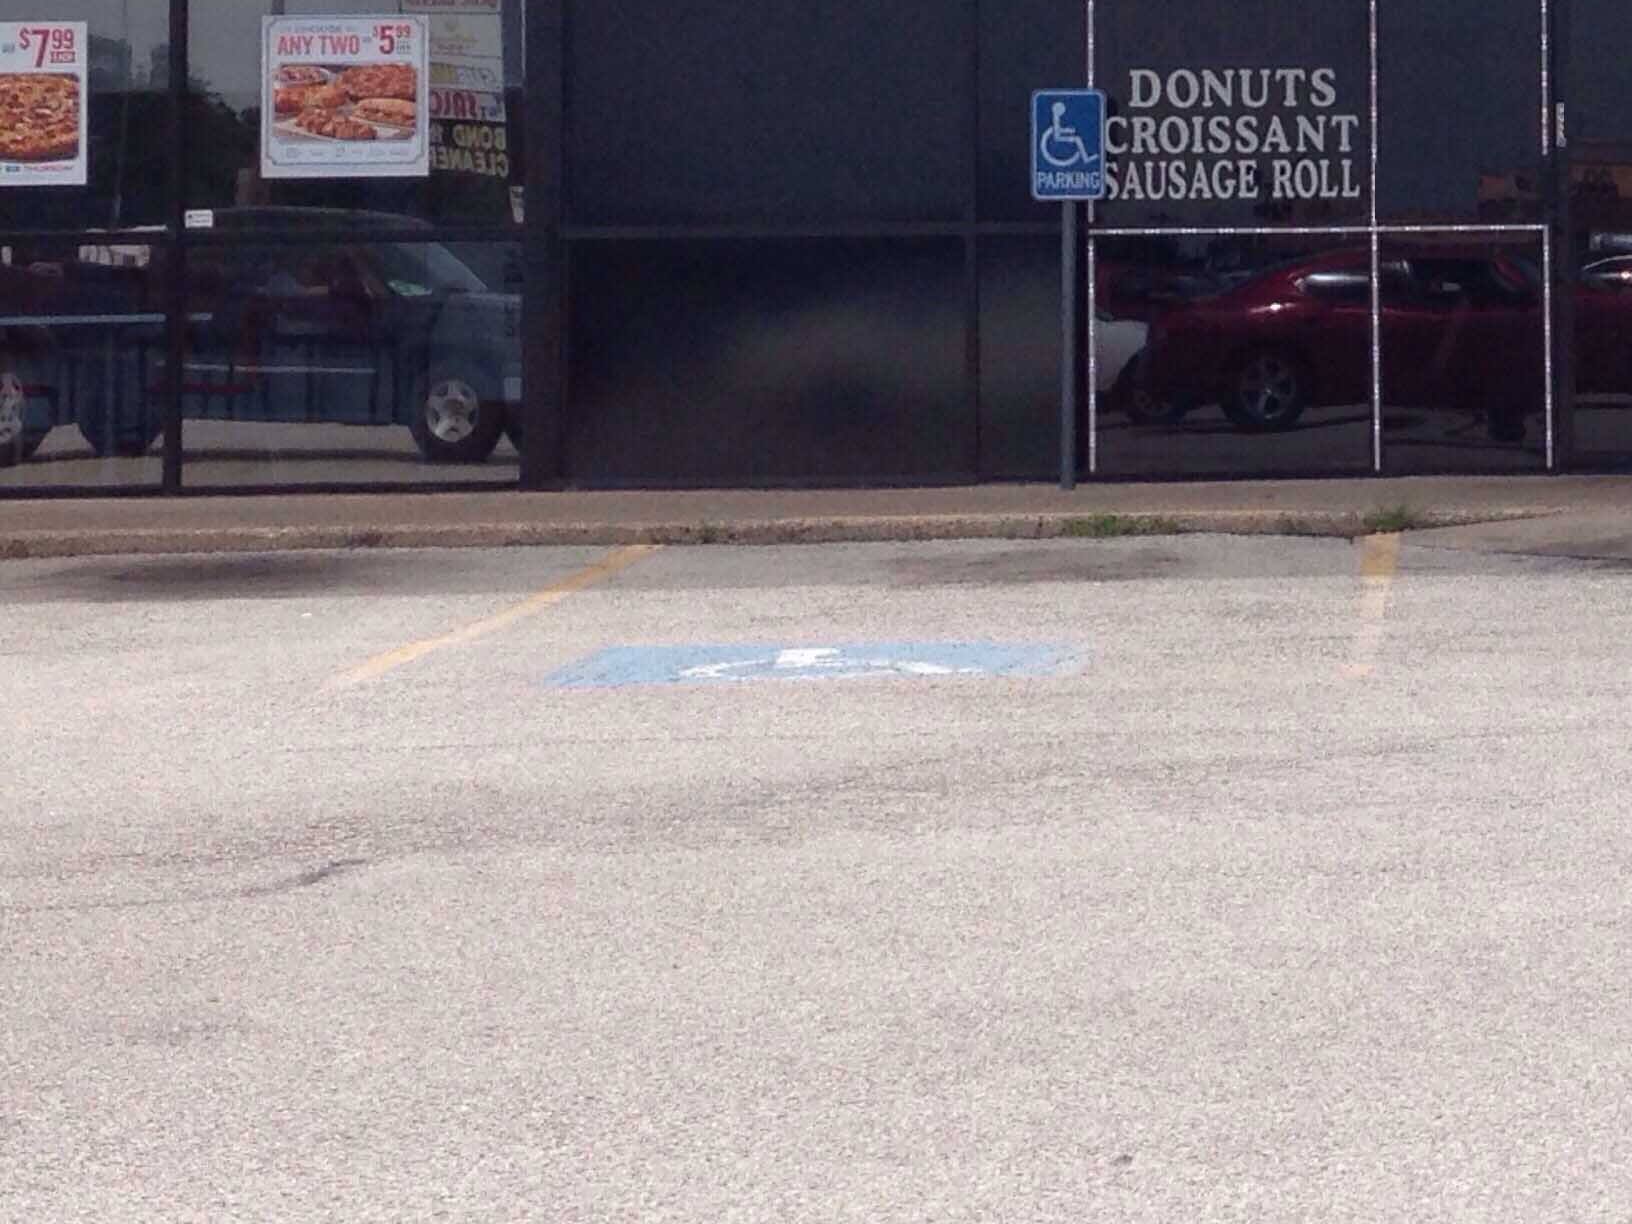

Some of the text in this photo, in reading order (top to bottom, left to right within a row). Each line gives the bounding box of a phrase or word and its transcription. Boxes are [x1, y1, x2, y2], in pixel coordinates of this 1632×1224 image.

[277, 35, 313, 55] ANY
[318, 35, 361, 55] TWO
[1128, 68, 1337, 108] DONUTS
[1105, 115, 1360, 155] CROISSANT
[1036, 171, 1101, 190] PARKING
[1105, 160, 1361, 200] SAUSAGE ROLL
